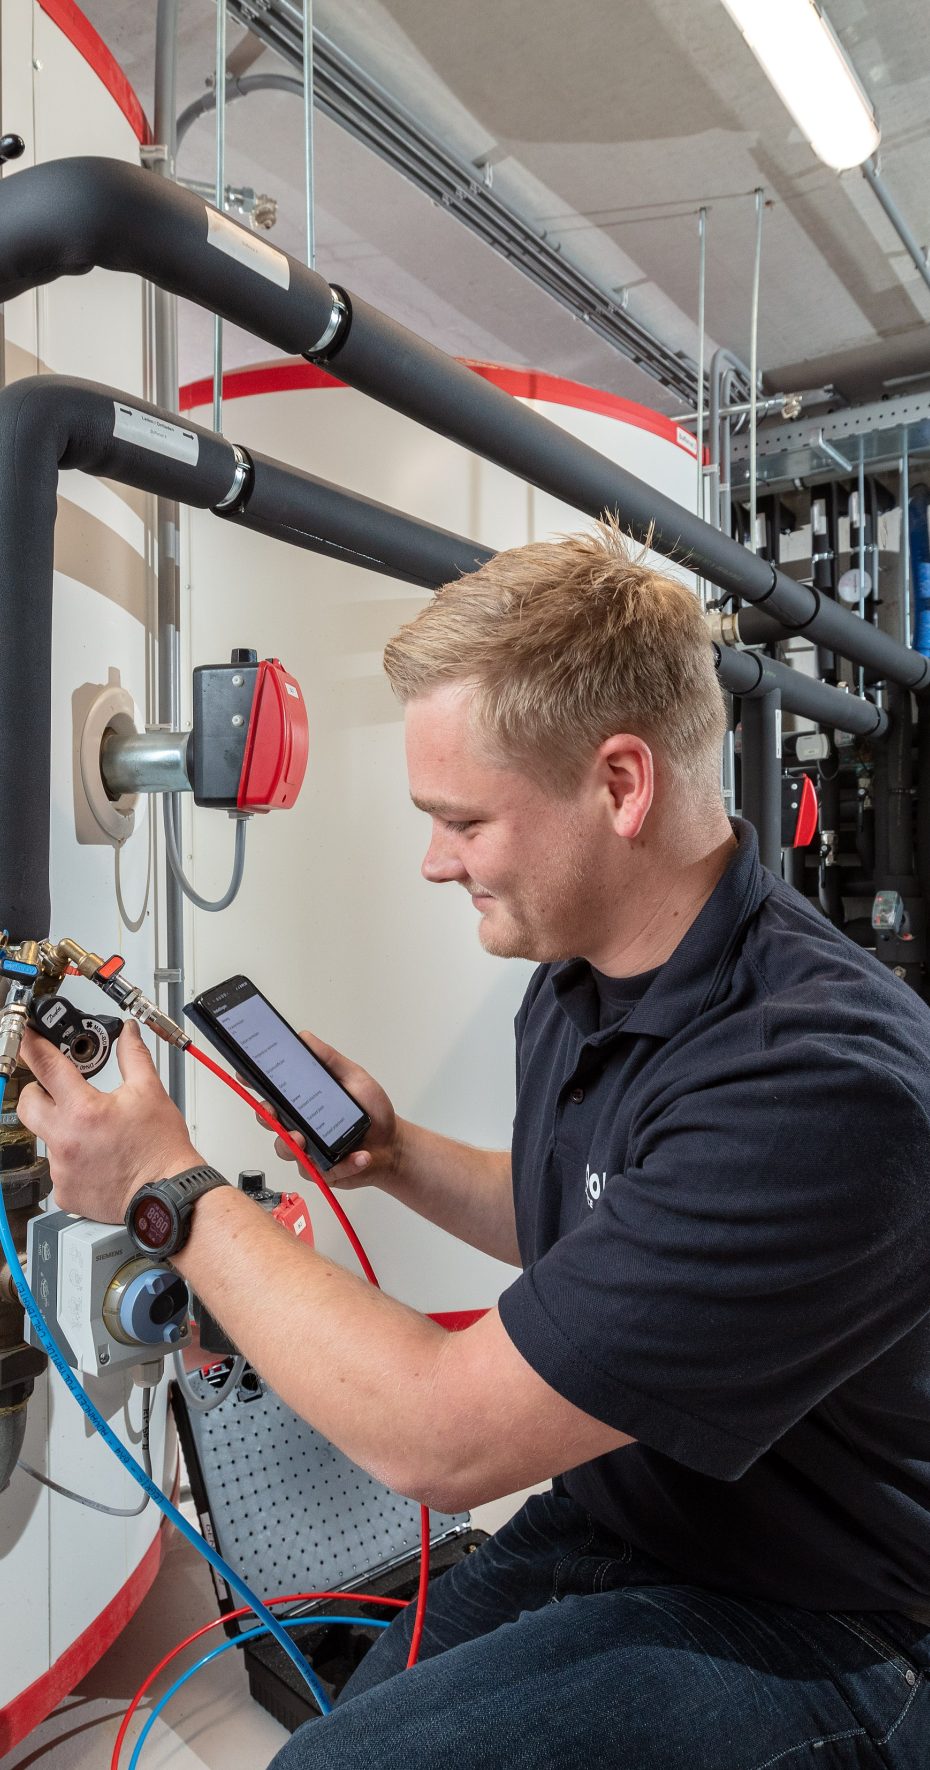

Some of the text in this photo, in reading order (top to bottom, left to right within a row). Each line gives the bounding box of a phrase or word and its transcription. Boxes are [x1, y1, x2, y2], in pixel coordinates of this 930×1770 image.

[95, 1249, 124, 1262] SIEMENS
[15, 1281, 46, 1339] CALIBRATED
[75, 1393, 108, 1437] ADVANCED
